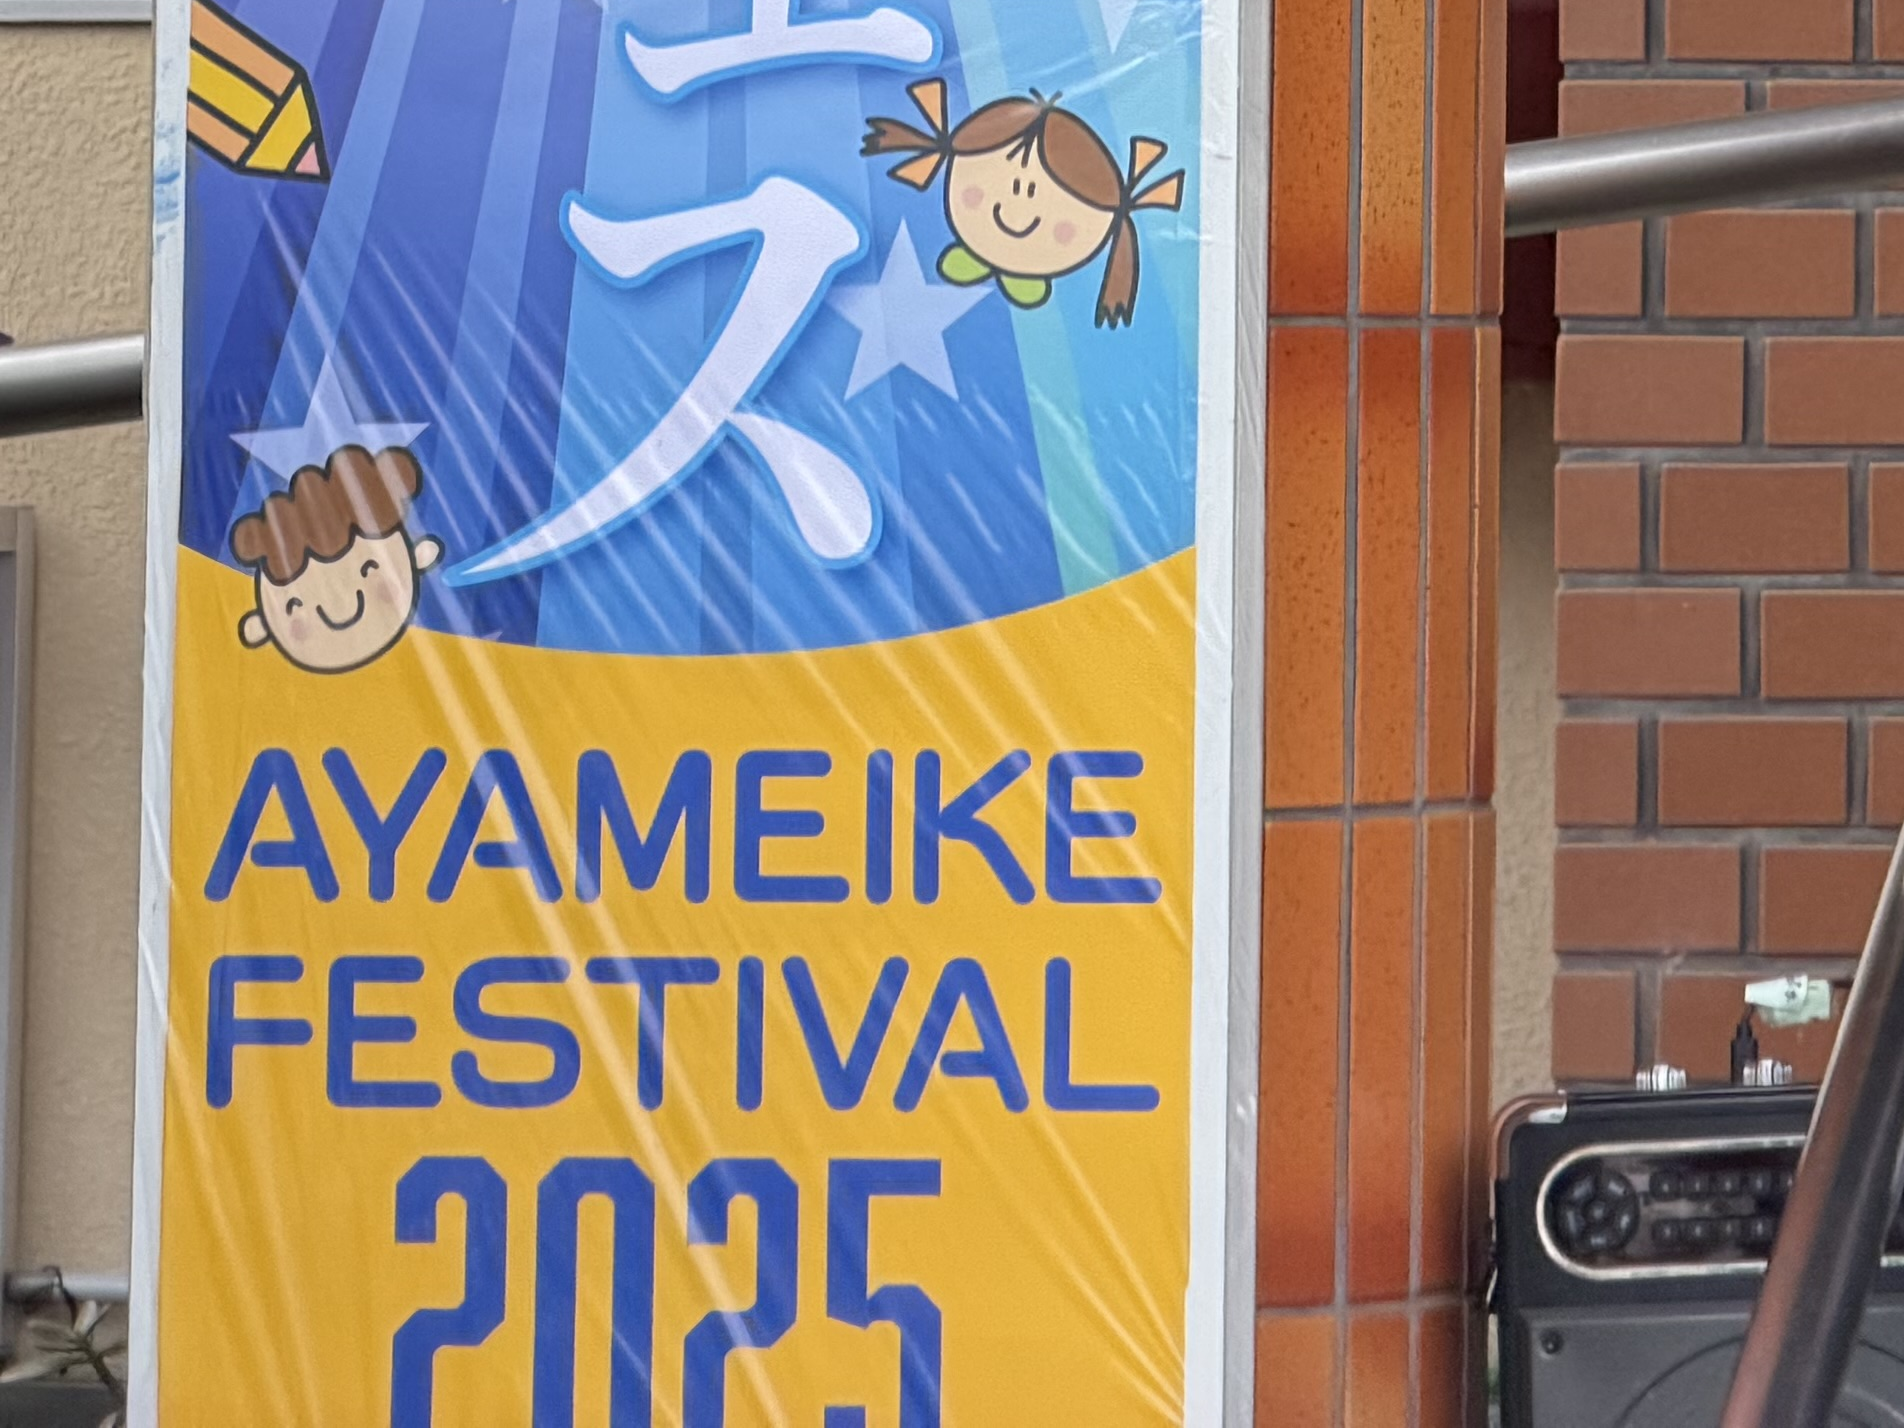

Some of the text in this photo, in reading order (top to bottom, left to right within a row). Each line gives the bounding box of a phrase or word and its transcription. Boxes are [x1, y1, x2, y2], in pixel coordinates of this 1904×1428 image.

[202, 745, 1164, 905] AYAMEIKE
[203, 952, 1162, 1114] FESTIVAL
[389, 1154, 944, 1428] 2025
